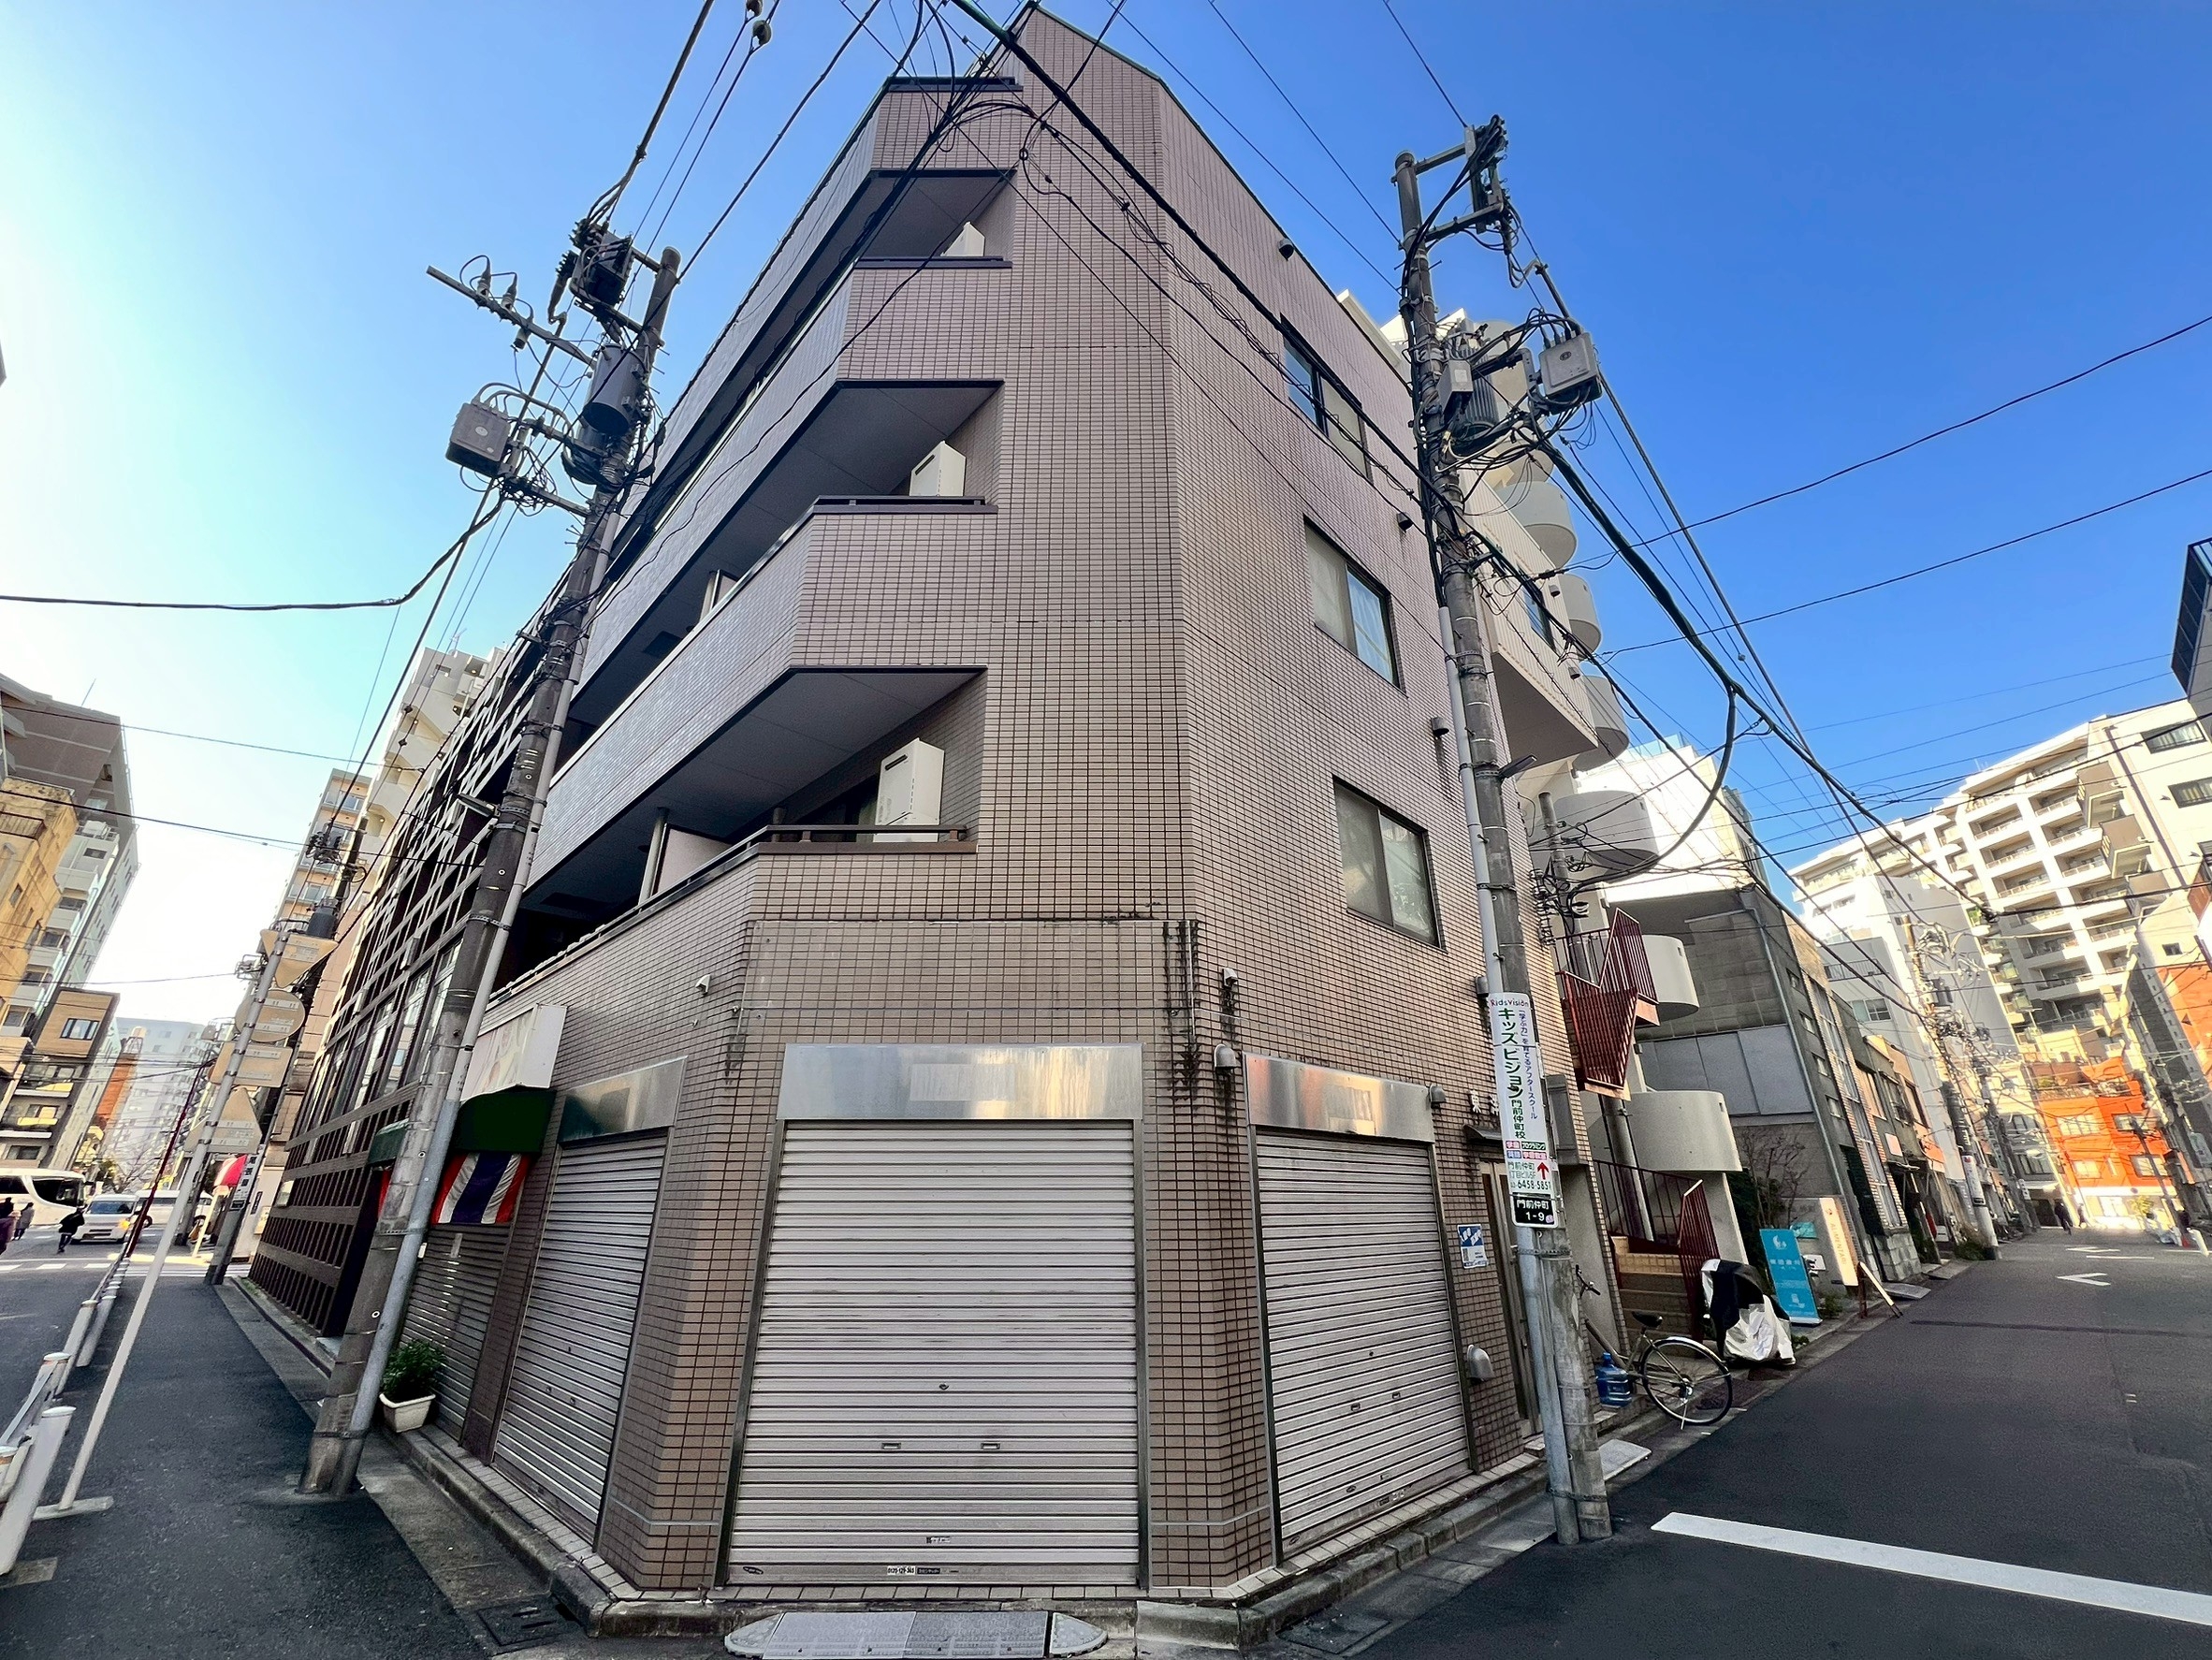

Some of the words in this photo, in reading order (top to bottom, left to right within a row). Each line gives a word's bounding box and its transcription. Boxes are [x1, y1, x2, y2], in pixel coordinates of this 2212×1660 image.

[1516, 1199, 1550, 1210] 門前仲町
[1525, 1211, 1545, 1222] 1-9
